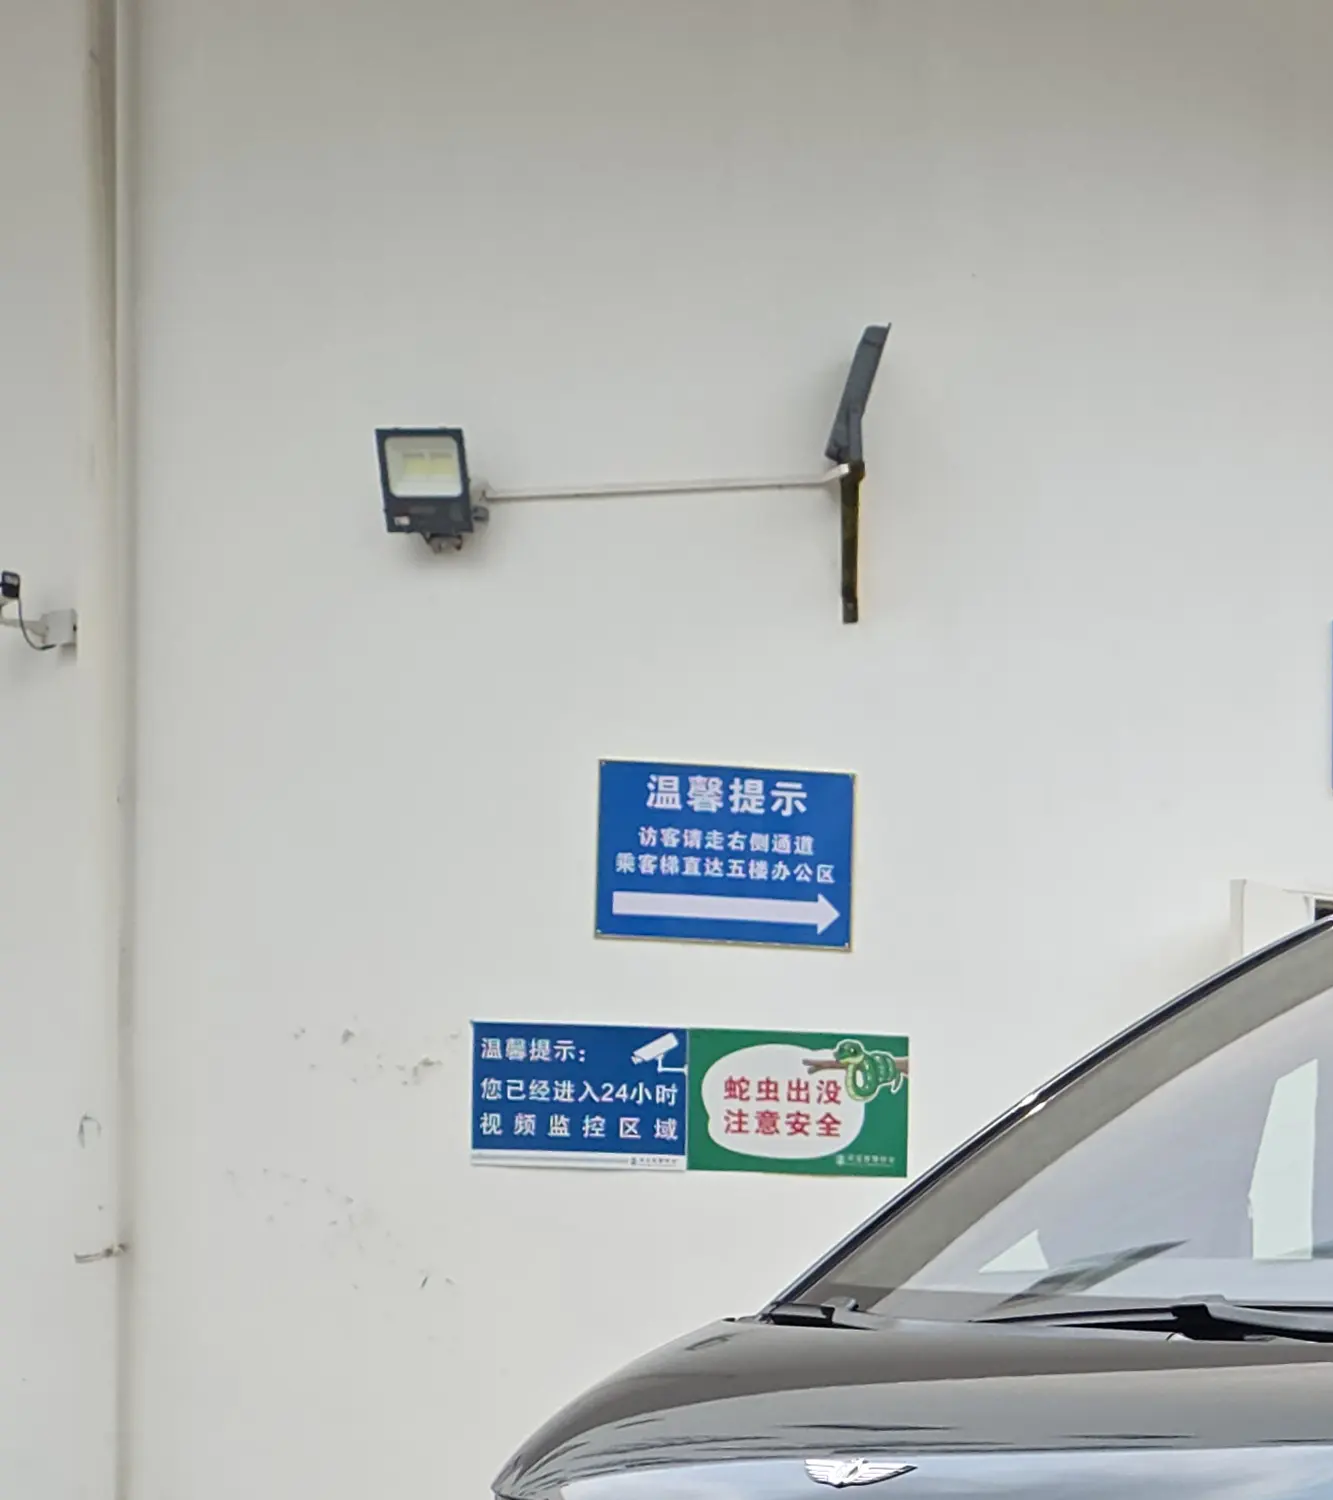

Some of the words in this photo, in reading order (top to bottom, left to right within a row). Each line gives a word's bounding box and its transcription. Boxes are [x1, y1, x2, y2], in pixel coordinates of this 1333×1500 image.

[646, 774, 808, 817] 温馨提示
[638, 826, 815, 856] 访客请走右侧通道
[615, 851, 836, 884] 乘客梯直达五楼办公区
[480, 1077, 678, 1107] 您已经进入24小时
[723, 1075, 842, 1106] 蛇虫出没
[480, 1112, 679, 1142] 视频监控区域
[723, 1108, 842, 1138] 注意安全
